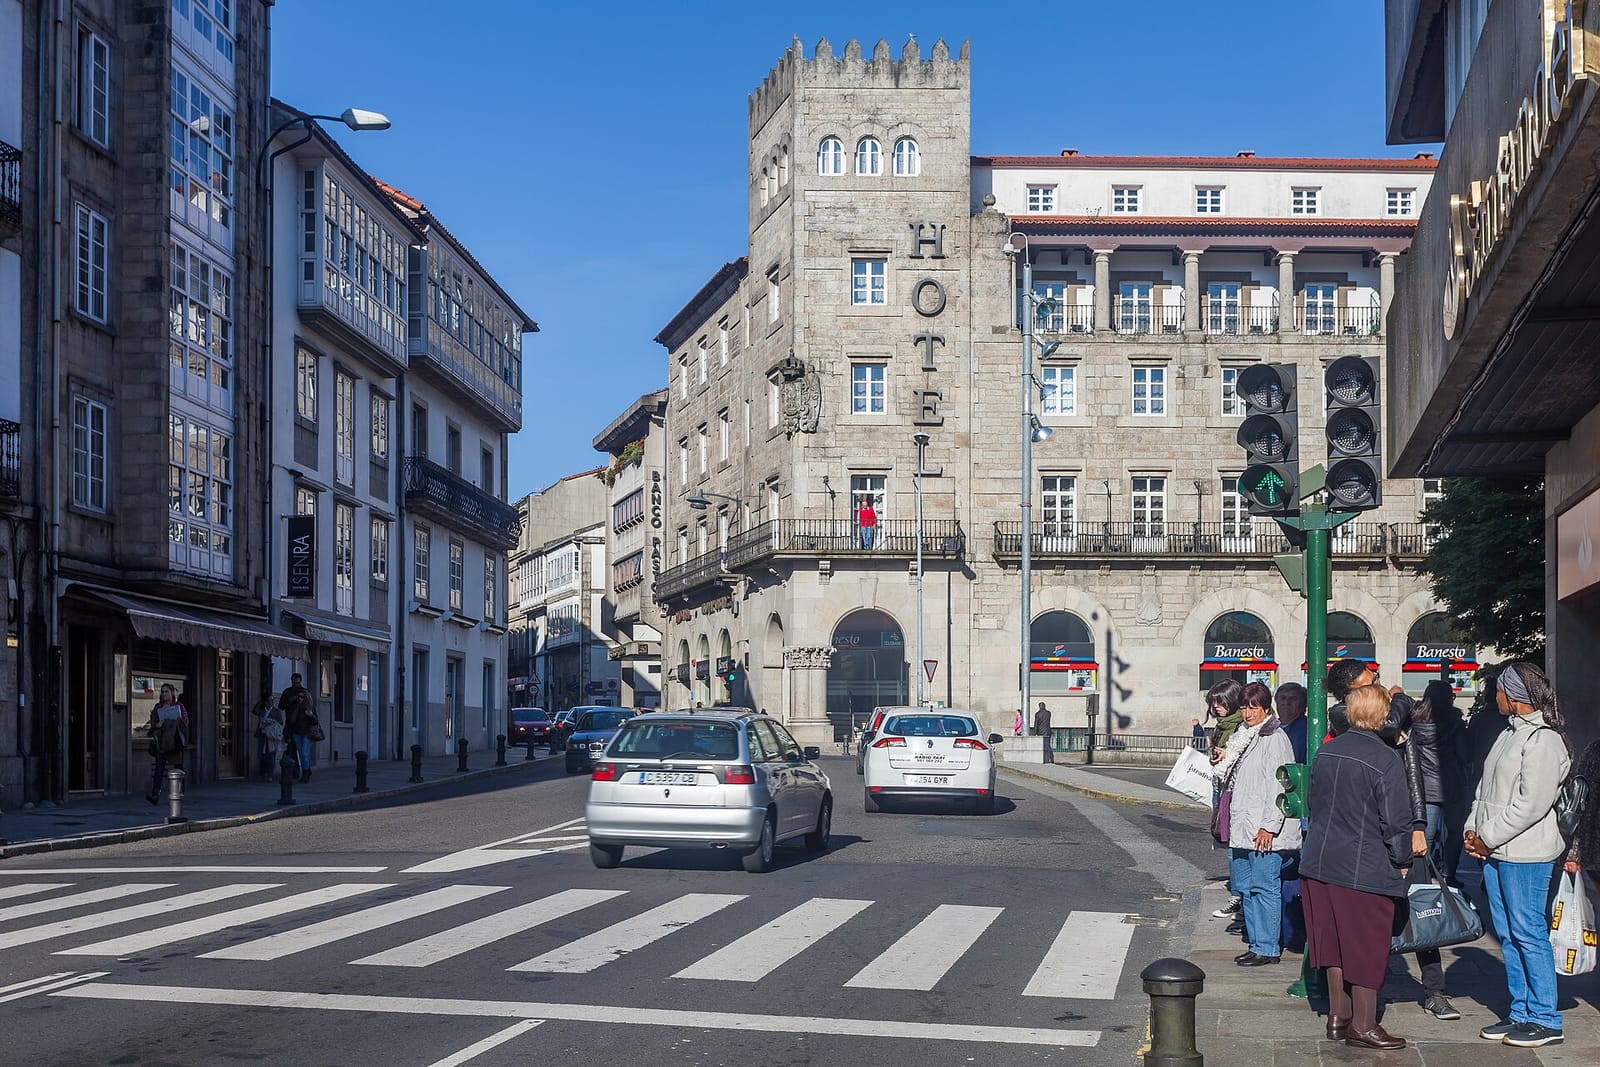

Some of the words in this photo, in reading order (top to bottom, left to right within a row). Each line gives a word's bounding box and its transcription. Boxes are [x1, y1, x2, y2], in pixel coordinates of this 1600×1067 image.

[909, 222, 947, 478] HOTEL
[651, 470, 662, 529] BANCO
[292, 534, 311, 585] SENRA
[1214, 644, 1265, 659] Banesto
[1416, 645, 1467, 658] Banesto
[646, 772, 653, 784] C
[933, 776, 948, 784] GYR
